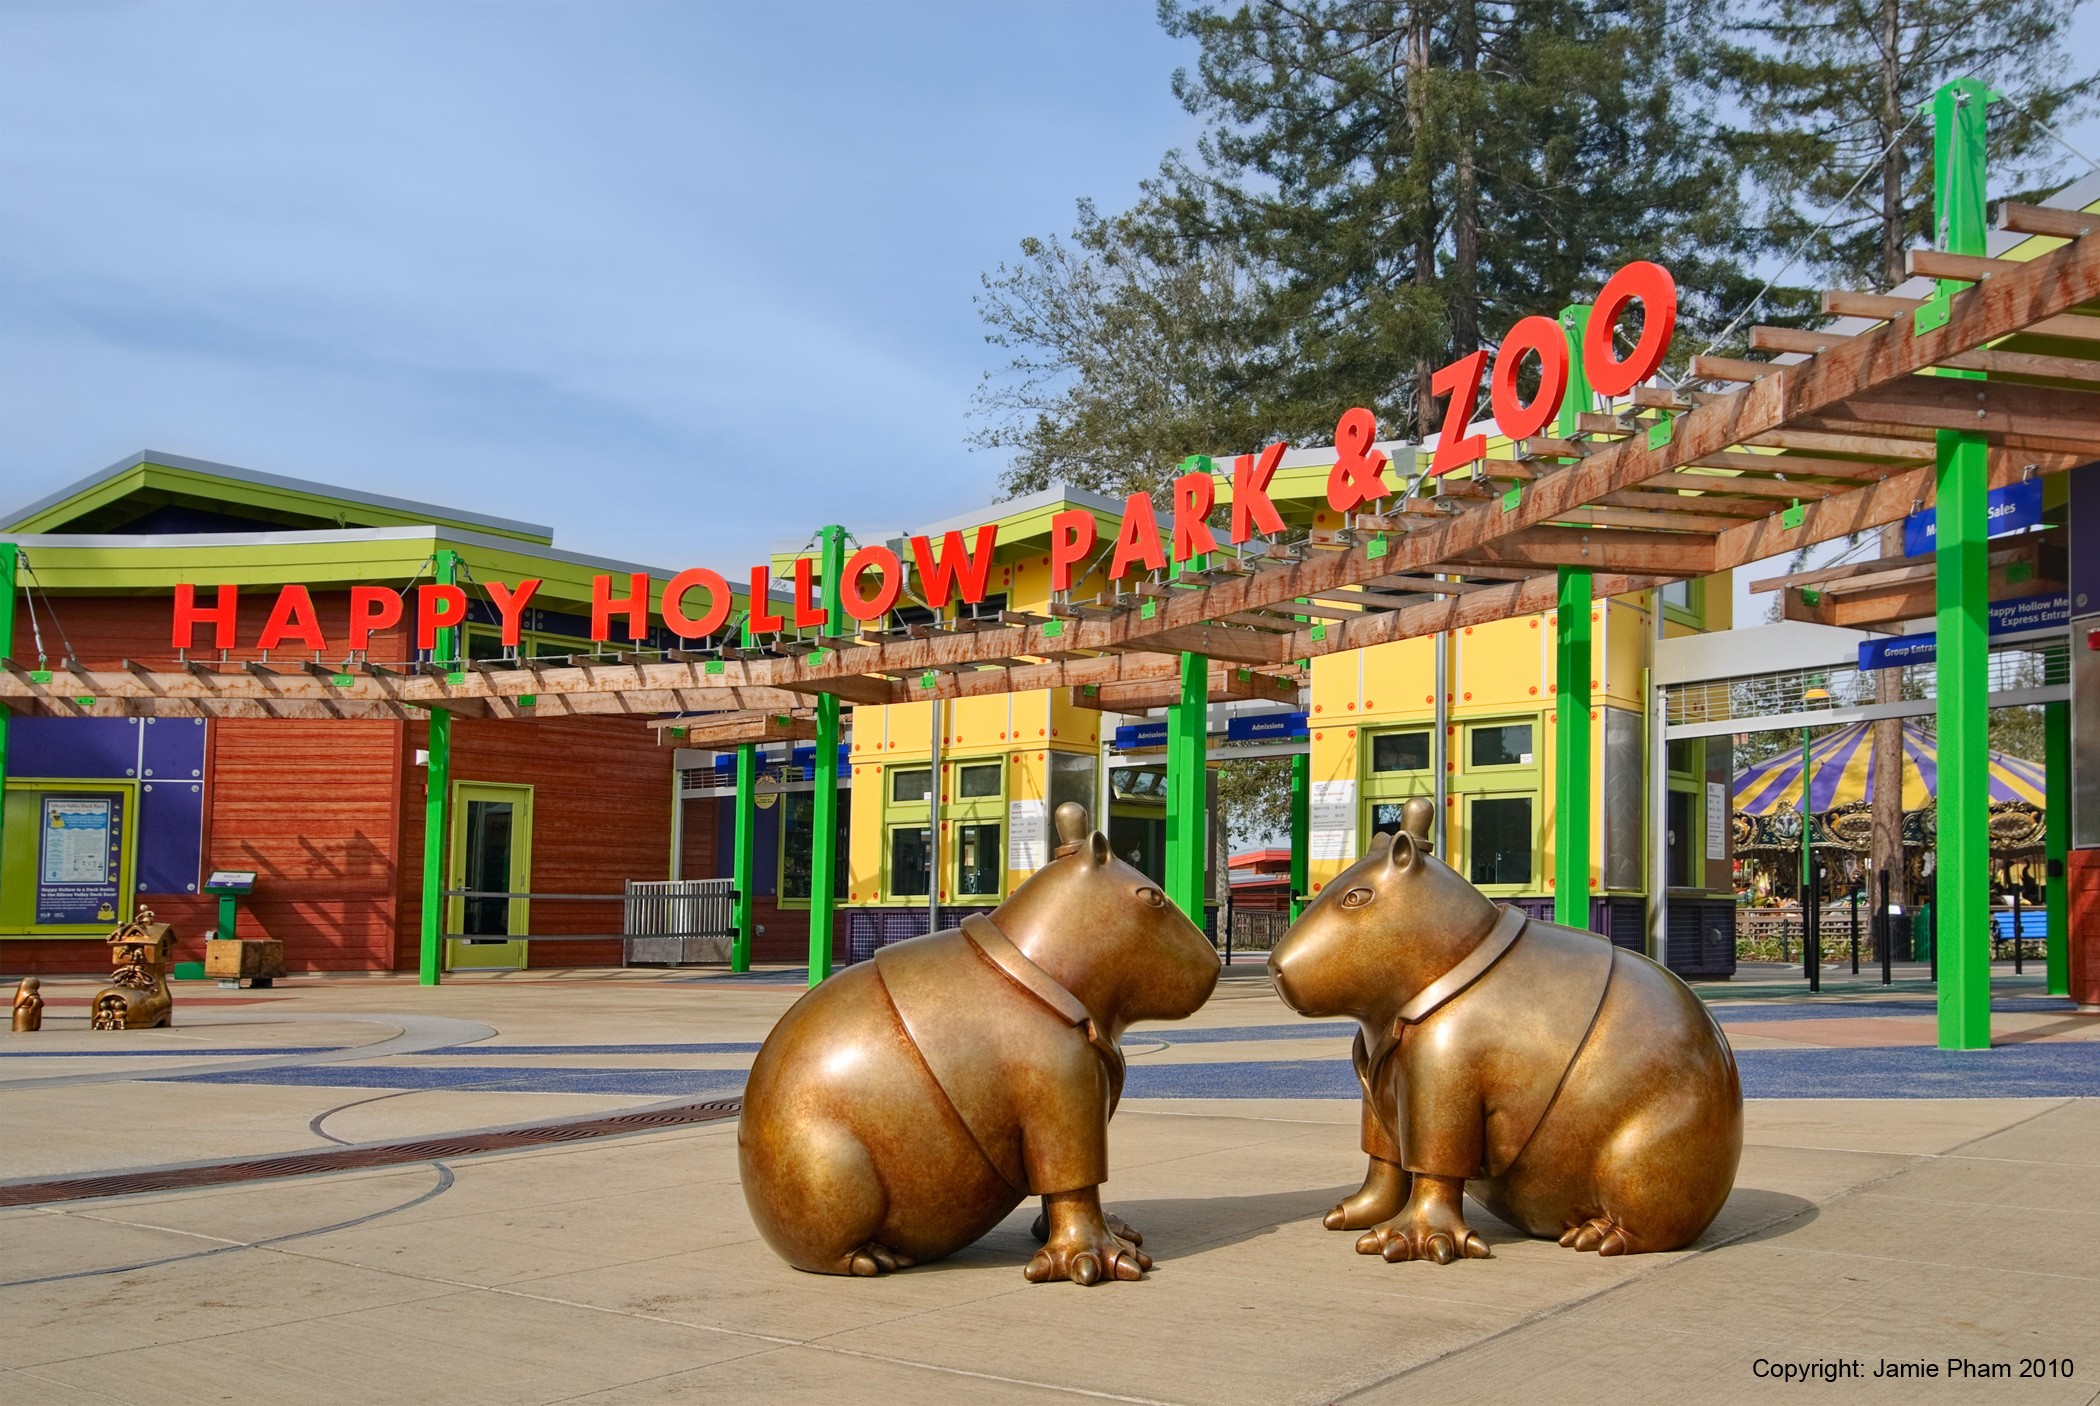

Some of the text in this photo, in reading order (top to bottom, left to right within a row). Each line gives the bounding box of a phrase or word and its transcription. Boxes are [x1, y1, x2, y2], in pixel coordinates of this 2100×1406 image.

[171, 261, 1677, 651] HAPPY HOLLOW PARK & ZOO
[1987, 503, 2016, 520] Sales
[1988, 606, 2017, 618] Happy
[2018, 601, 2052, 613] Hollow
[2001, 614, 2040, 627] Express
[1884, 646, 1910, 658] Group
[1252, 721, 1284, 732] Admissions
[1137, 731, 1168, 740] Admissions
